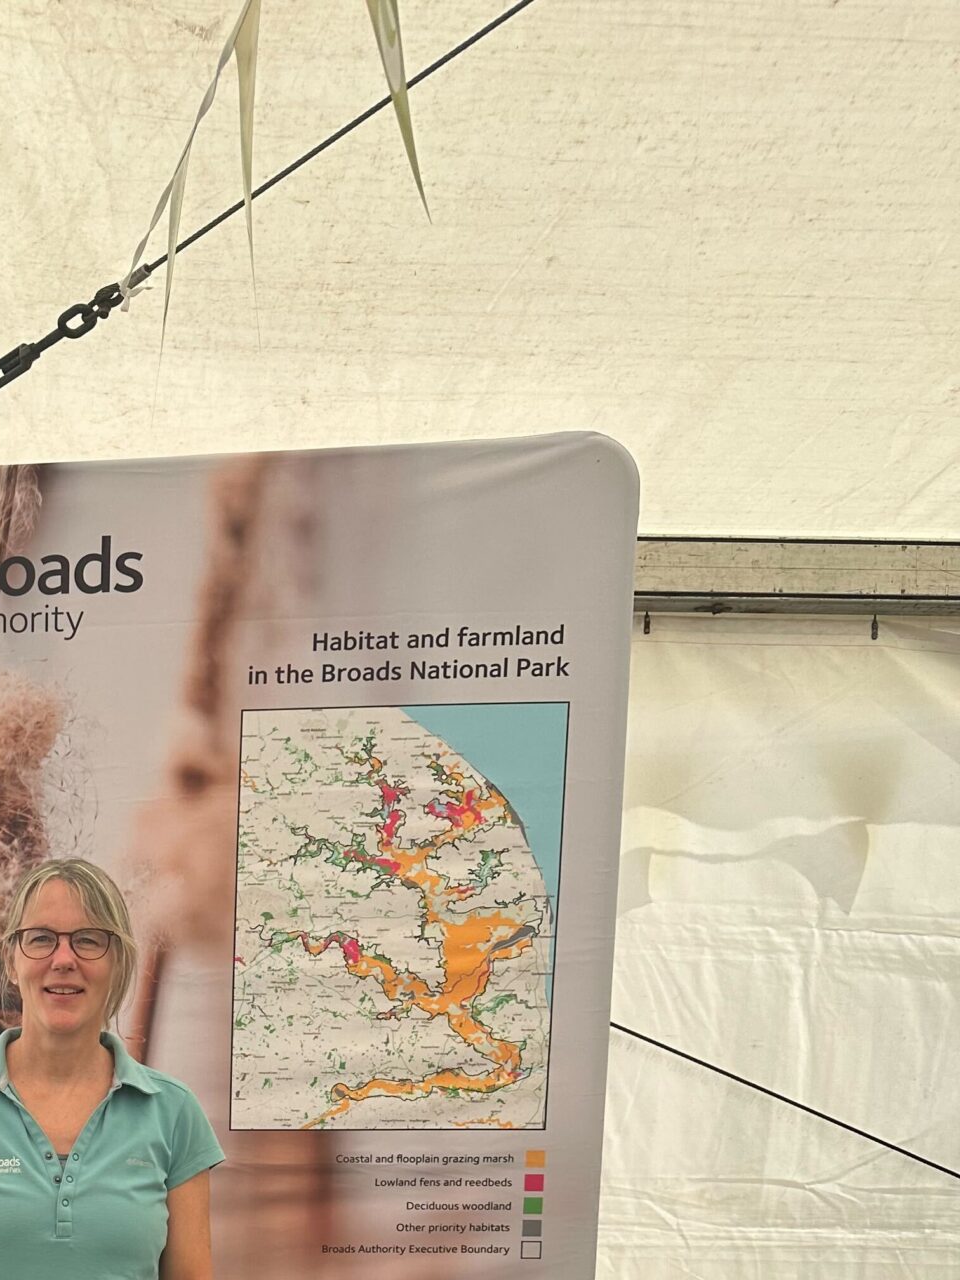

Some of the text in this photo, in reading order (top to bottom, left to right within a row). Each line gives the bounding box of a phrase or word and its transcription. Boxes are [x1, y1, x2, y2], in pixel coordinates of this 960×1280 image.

[312, 624, 565, 652] Habitat and farmland
[248, 656, 570, 685] in the Broads National Park
[335, 1154, 515, 1166] Coastal and flooplain grazing marsh
[374, 1178, 513, 1187] Lowland fens and reedbeds
[406, 1201, 512, 1211] Deciduous woodland
[396, 1222, 511, 1234] Other priority habitats
[322, 1244, 510, 1255] Broads Authority Executive Boundary
